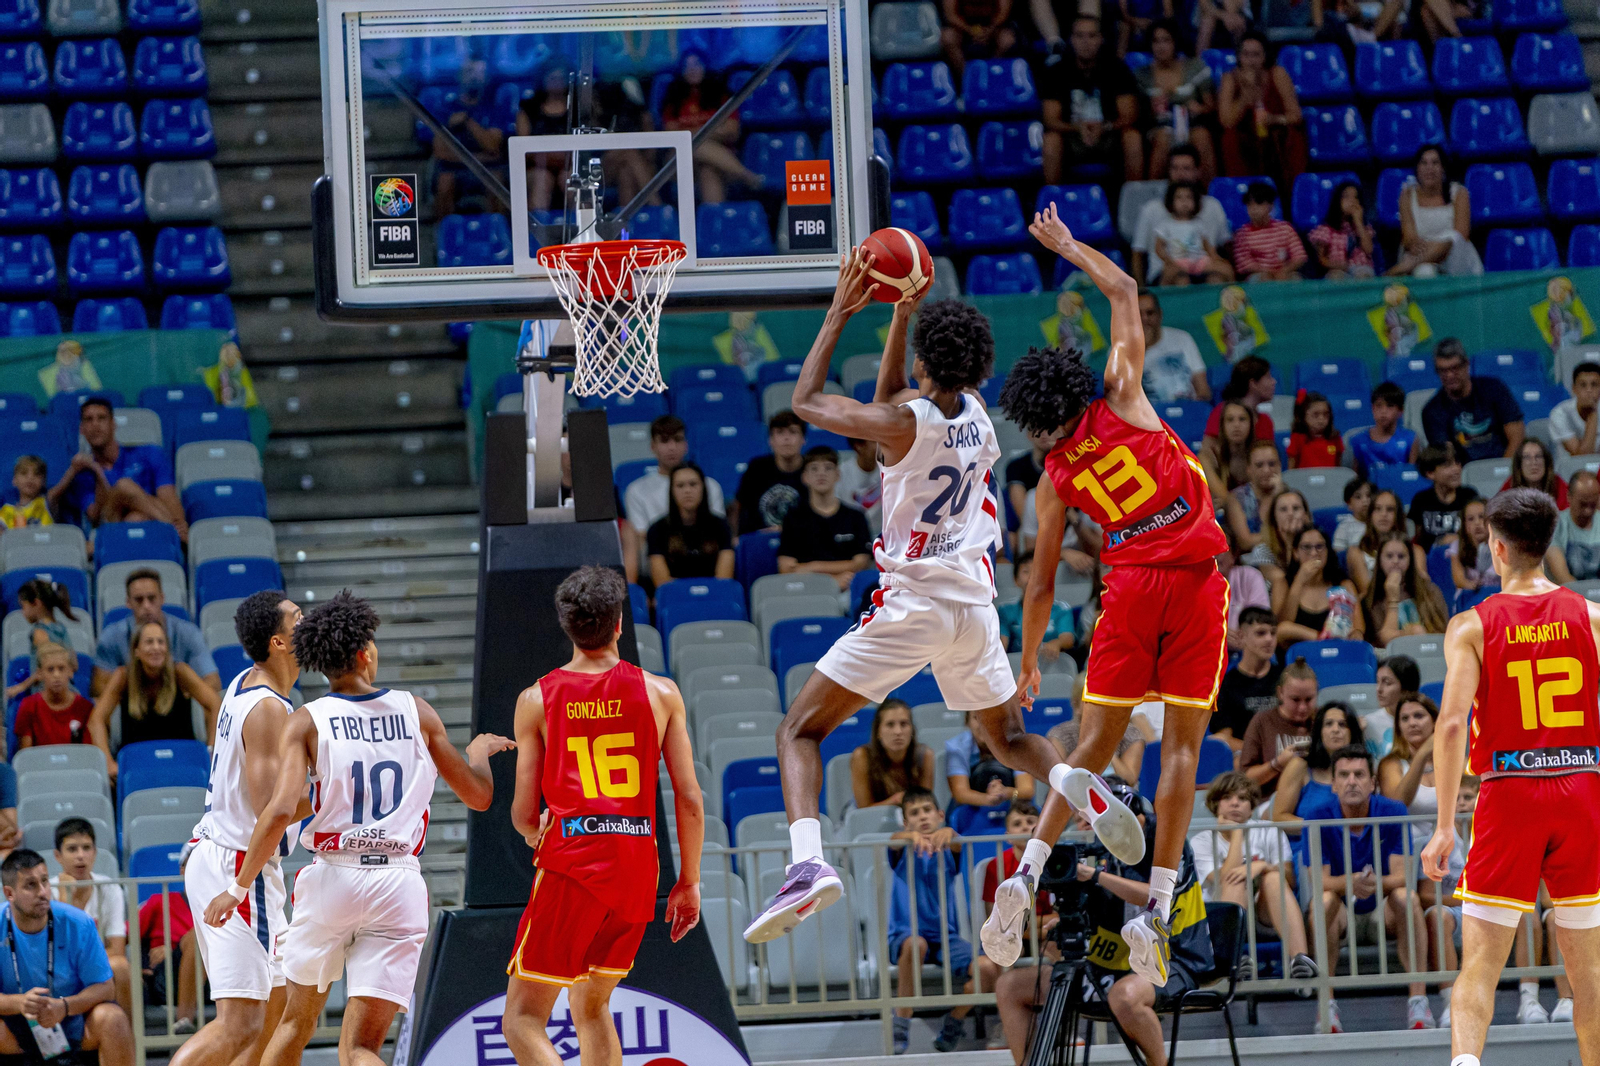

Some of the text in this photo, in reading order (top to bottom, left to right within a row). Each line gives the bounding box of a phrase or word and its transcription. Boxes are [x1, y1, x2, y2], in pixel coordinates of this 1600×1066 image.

[791, 173, 825, 182] CLEAN
[791, 183, 825, 192] GAME
[379, 225, 411, 242] FIBA
[795, 219, 826, 236] FIBA
[921, 462, 978, 525] 20
[1072, 445, 1158, 523] 13
[1505, 620, 1569, 644] LANGARITA
[1506, 656, 1585, 730] 12
[566, 698, 623, 720] GONZÁLEZ
[328, 714, 413, 743] FIBLEUIL
[566, 732, 641, 799] 16
[1519, 749, 1595, 769] CaixaBank
[350, 760, 403, 825] 10
[583, 816, 651, 834] CaixaBank
[1090, 936, 1118, 961] HB
